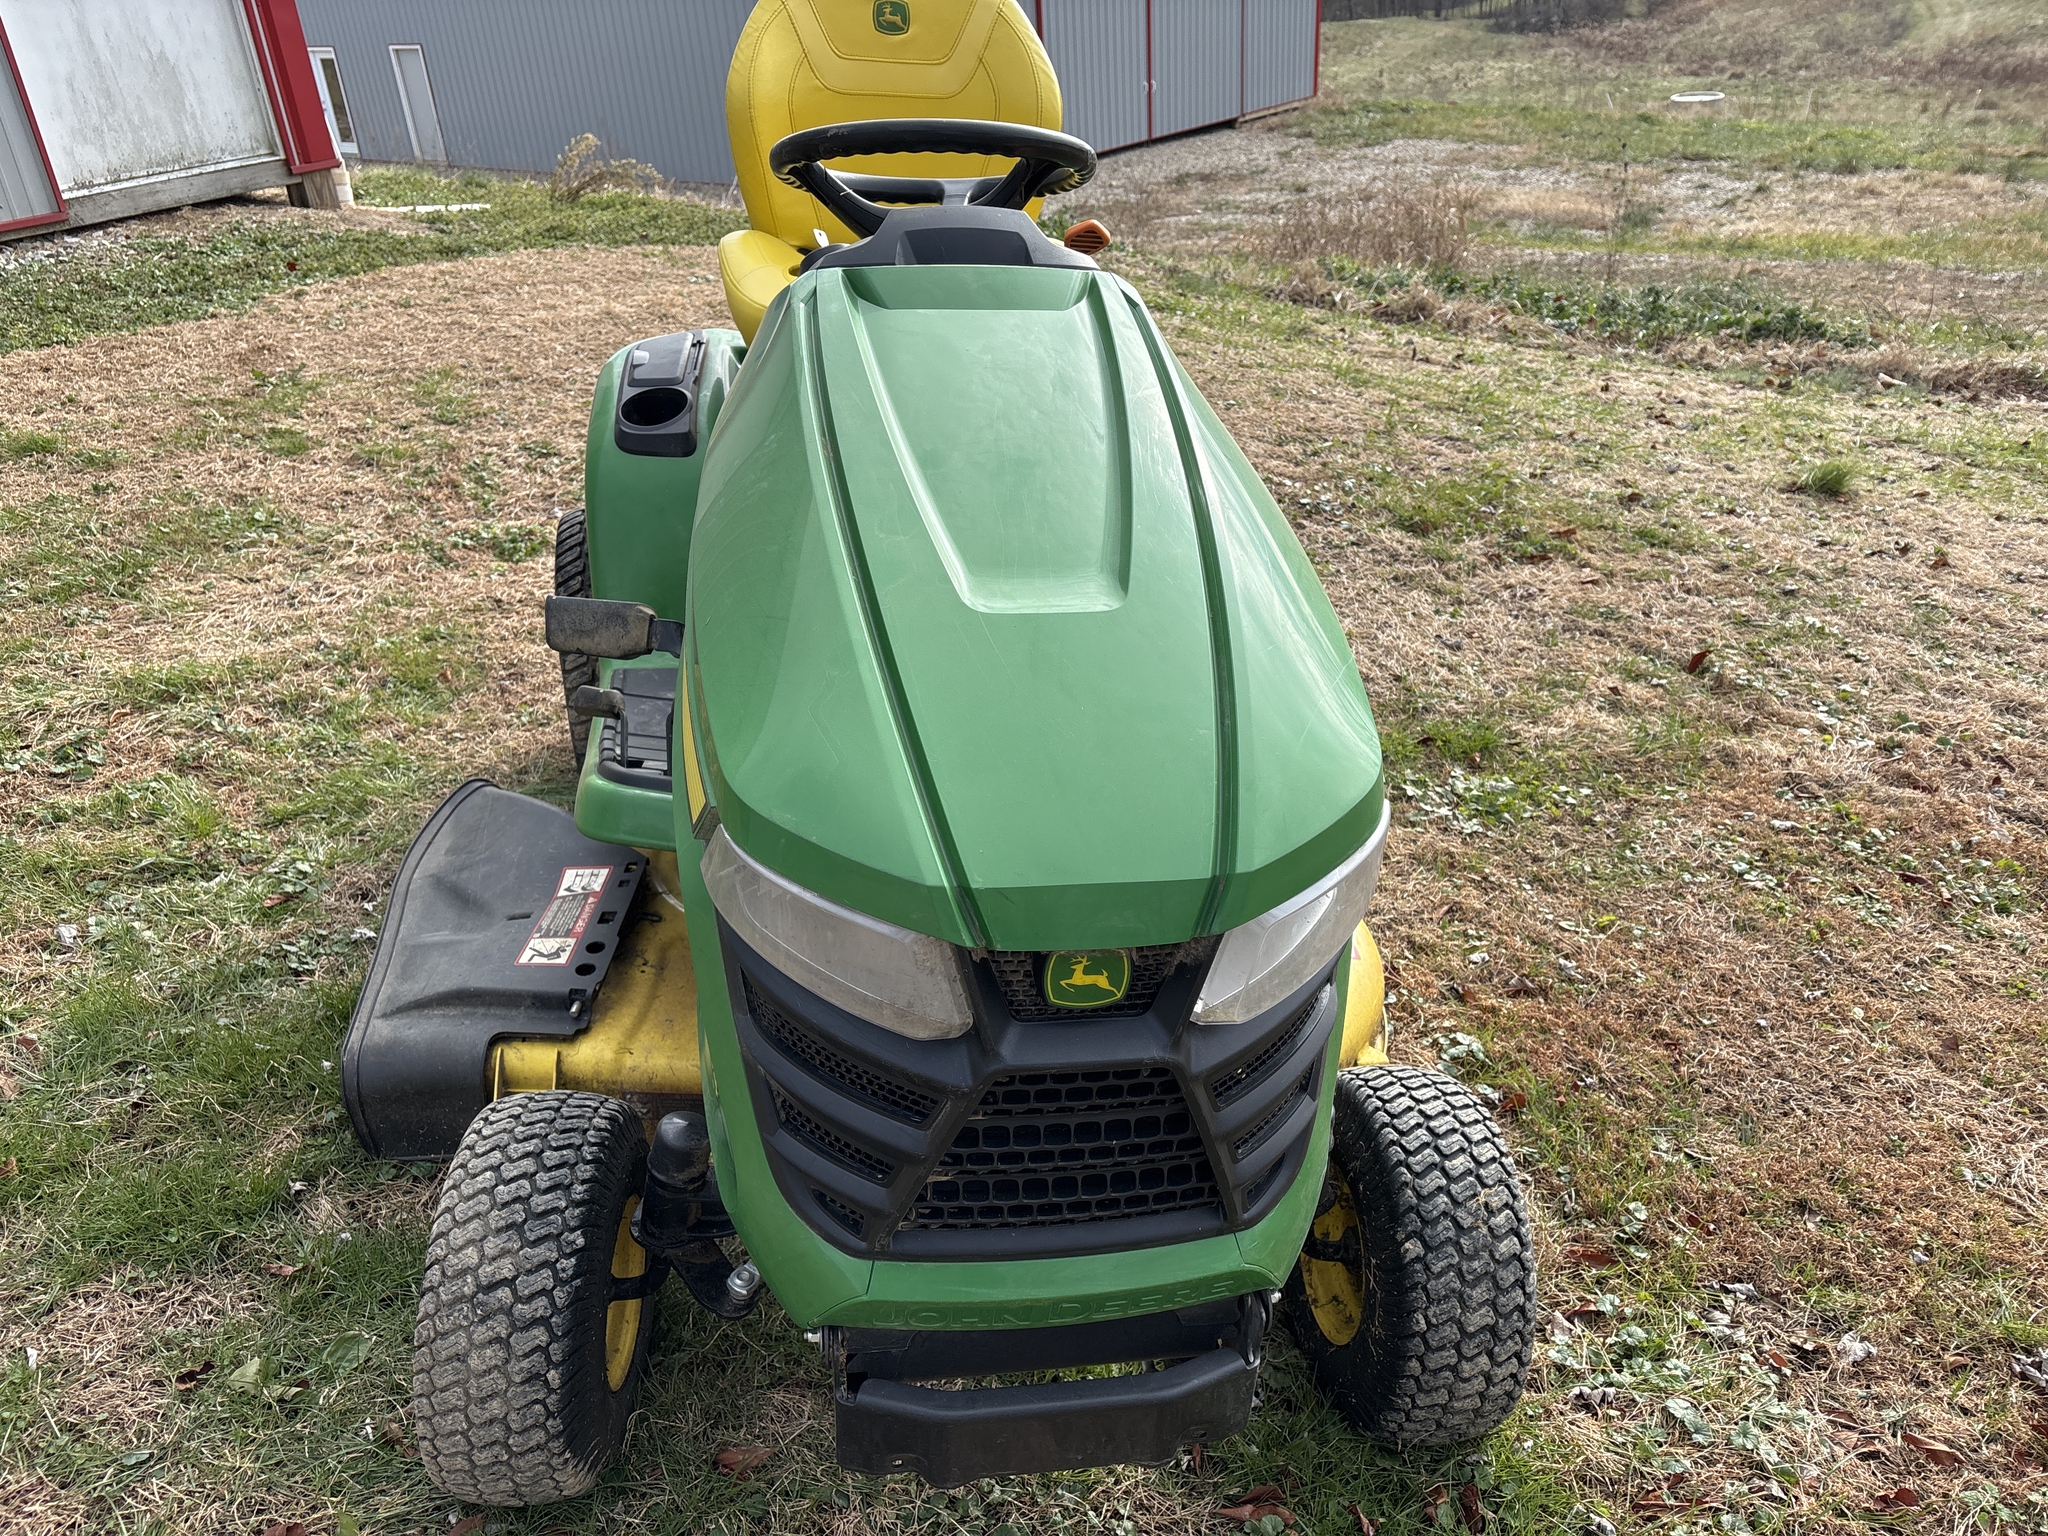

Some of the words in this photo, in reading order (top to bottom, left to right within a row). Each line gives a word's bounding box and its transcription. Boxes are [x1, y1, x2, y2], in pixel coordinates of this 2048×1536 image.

[573, 904, 595, 933] DANGER
[872, 1303, 1031, 1327] JOHN
[1047, 1280, 1235, 1323] DEERE
